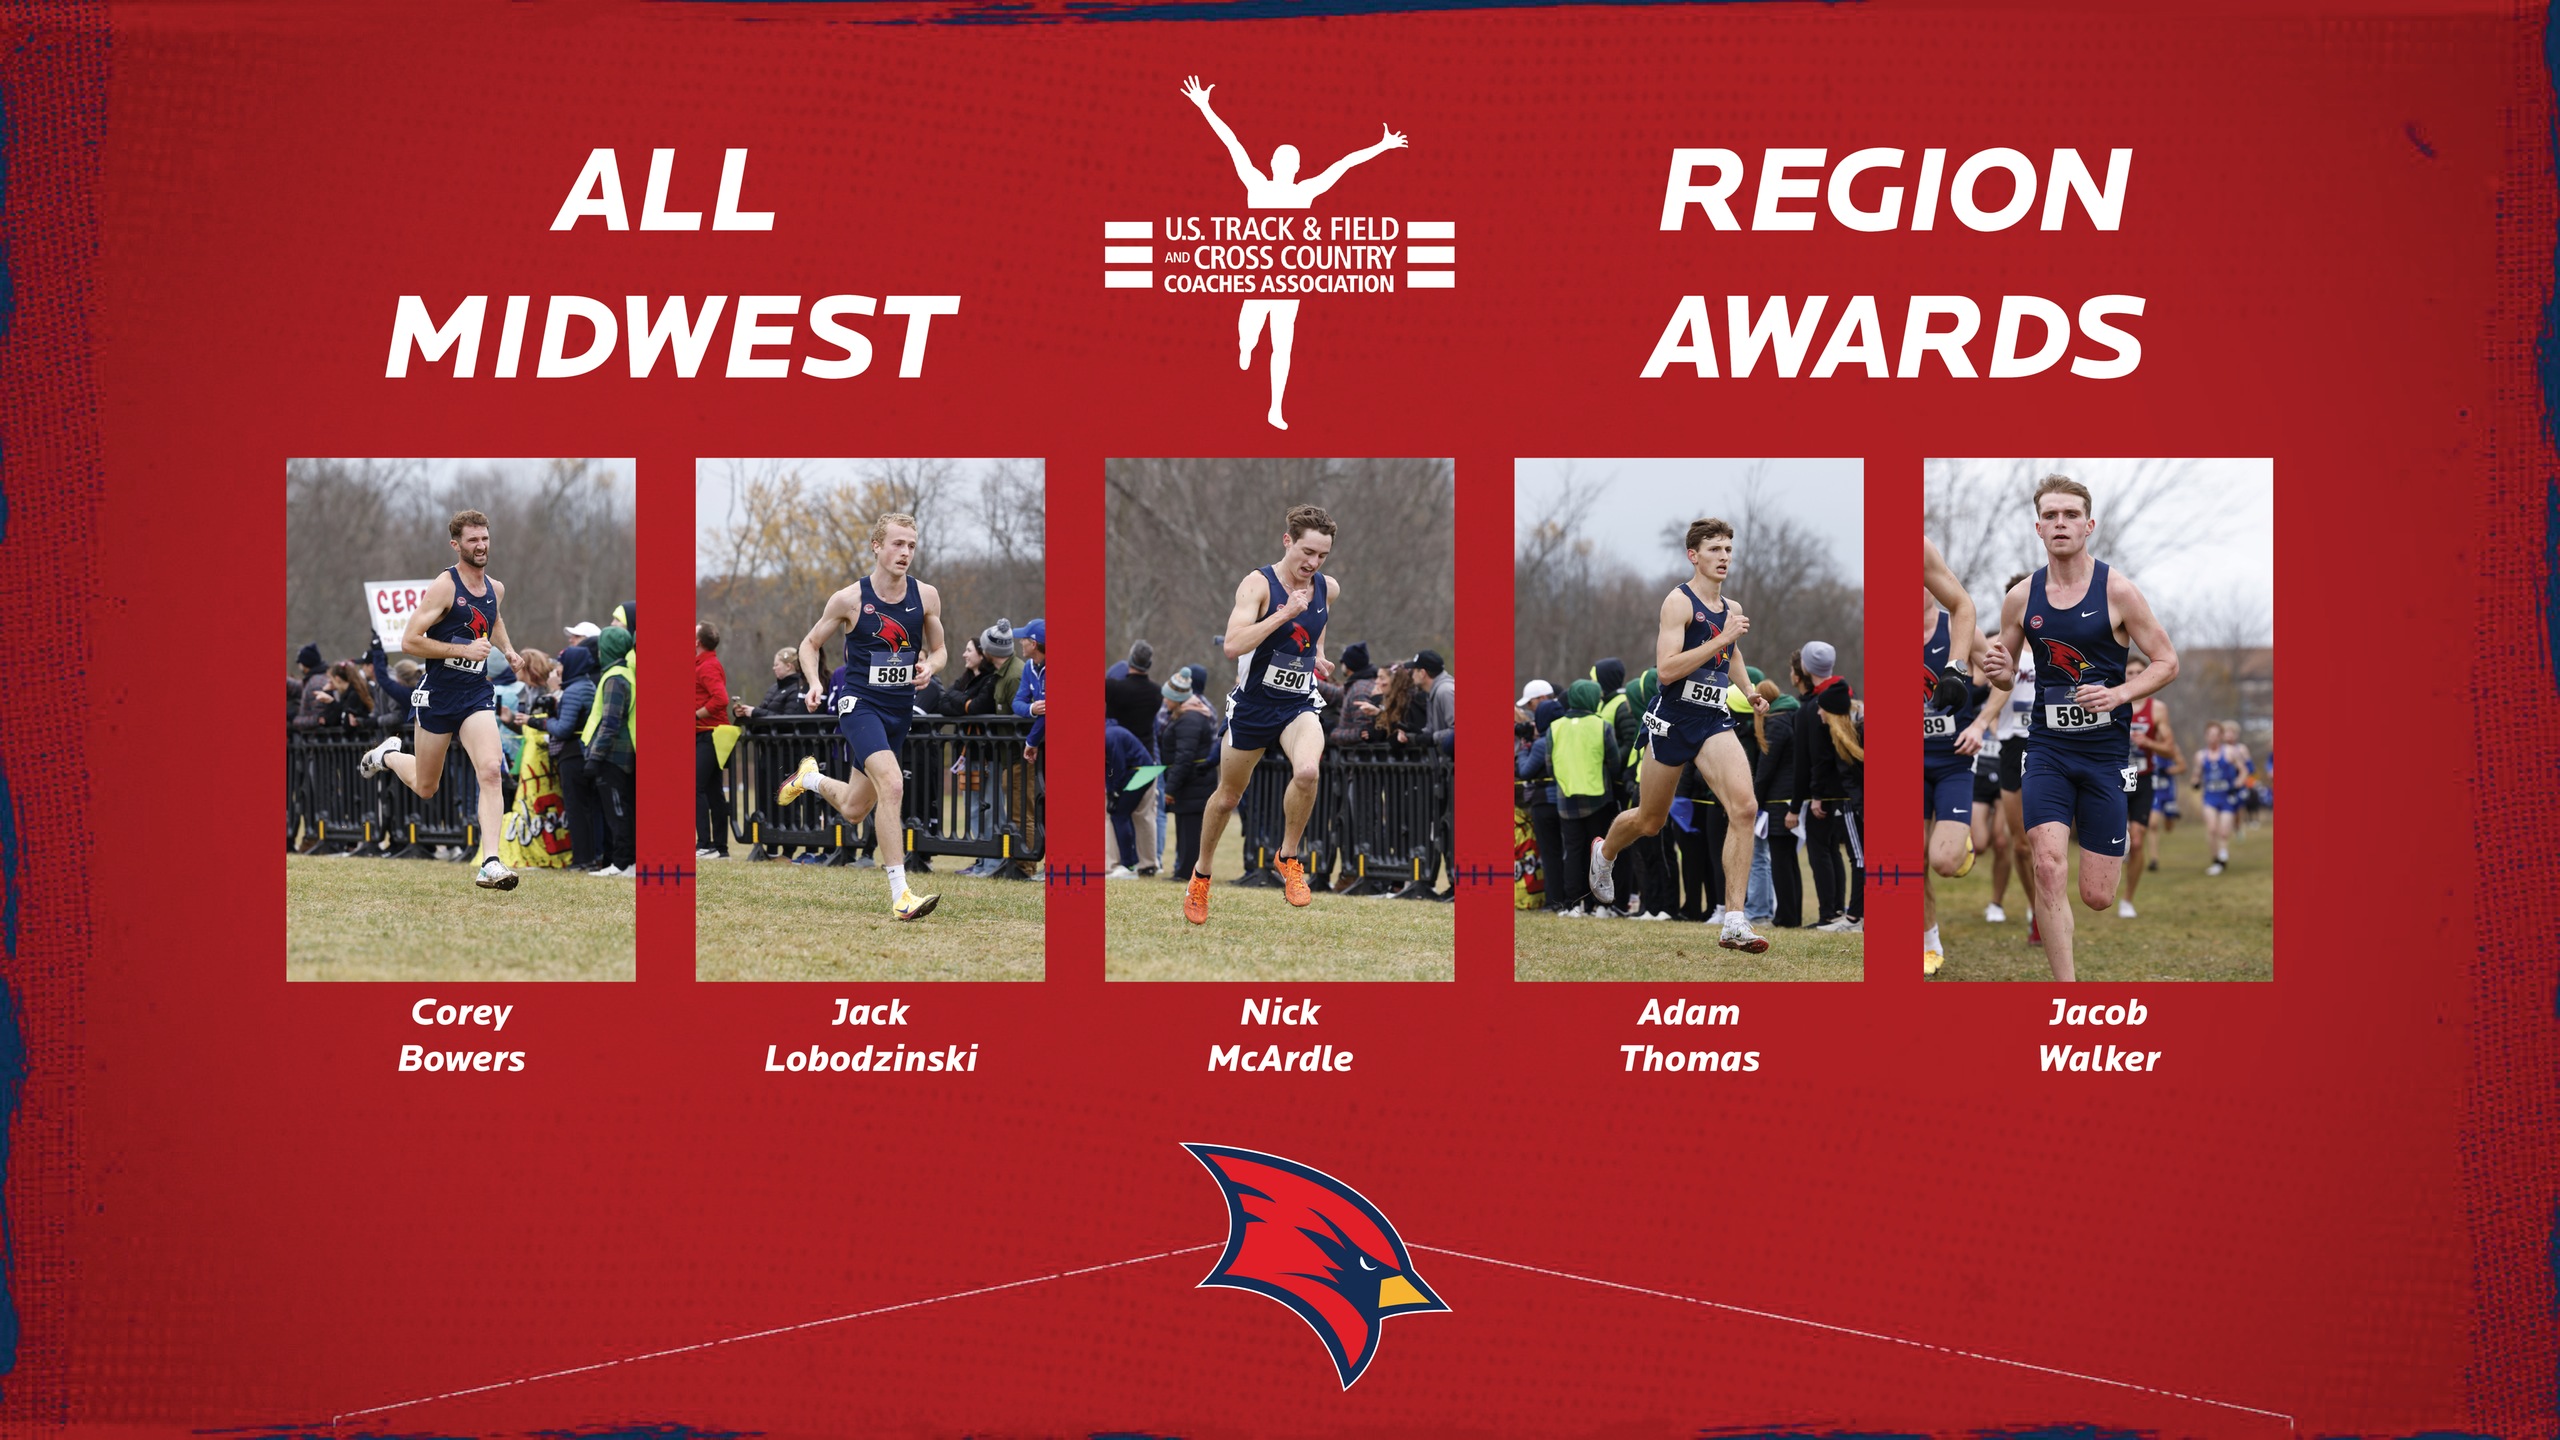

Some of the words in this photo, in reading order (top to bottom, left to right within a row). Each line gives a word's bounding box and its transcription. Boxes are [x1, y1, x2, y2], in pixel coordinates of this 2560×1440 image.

[877, 667, 907, 684] 589
[1273, 669, 1305, 689] 590
[1691, 684, 1721, 704] 594
[1645, 715, 1662, 733] 594
[2056, 705, 2099, 728] 595
[1924, 718, 1946, 735] 89
